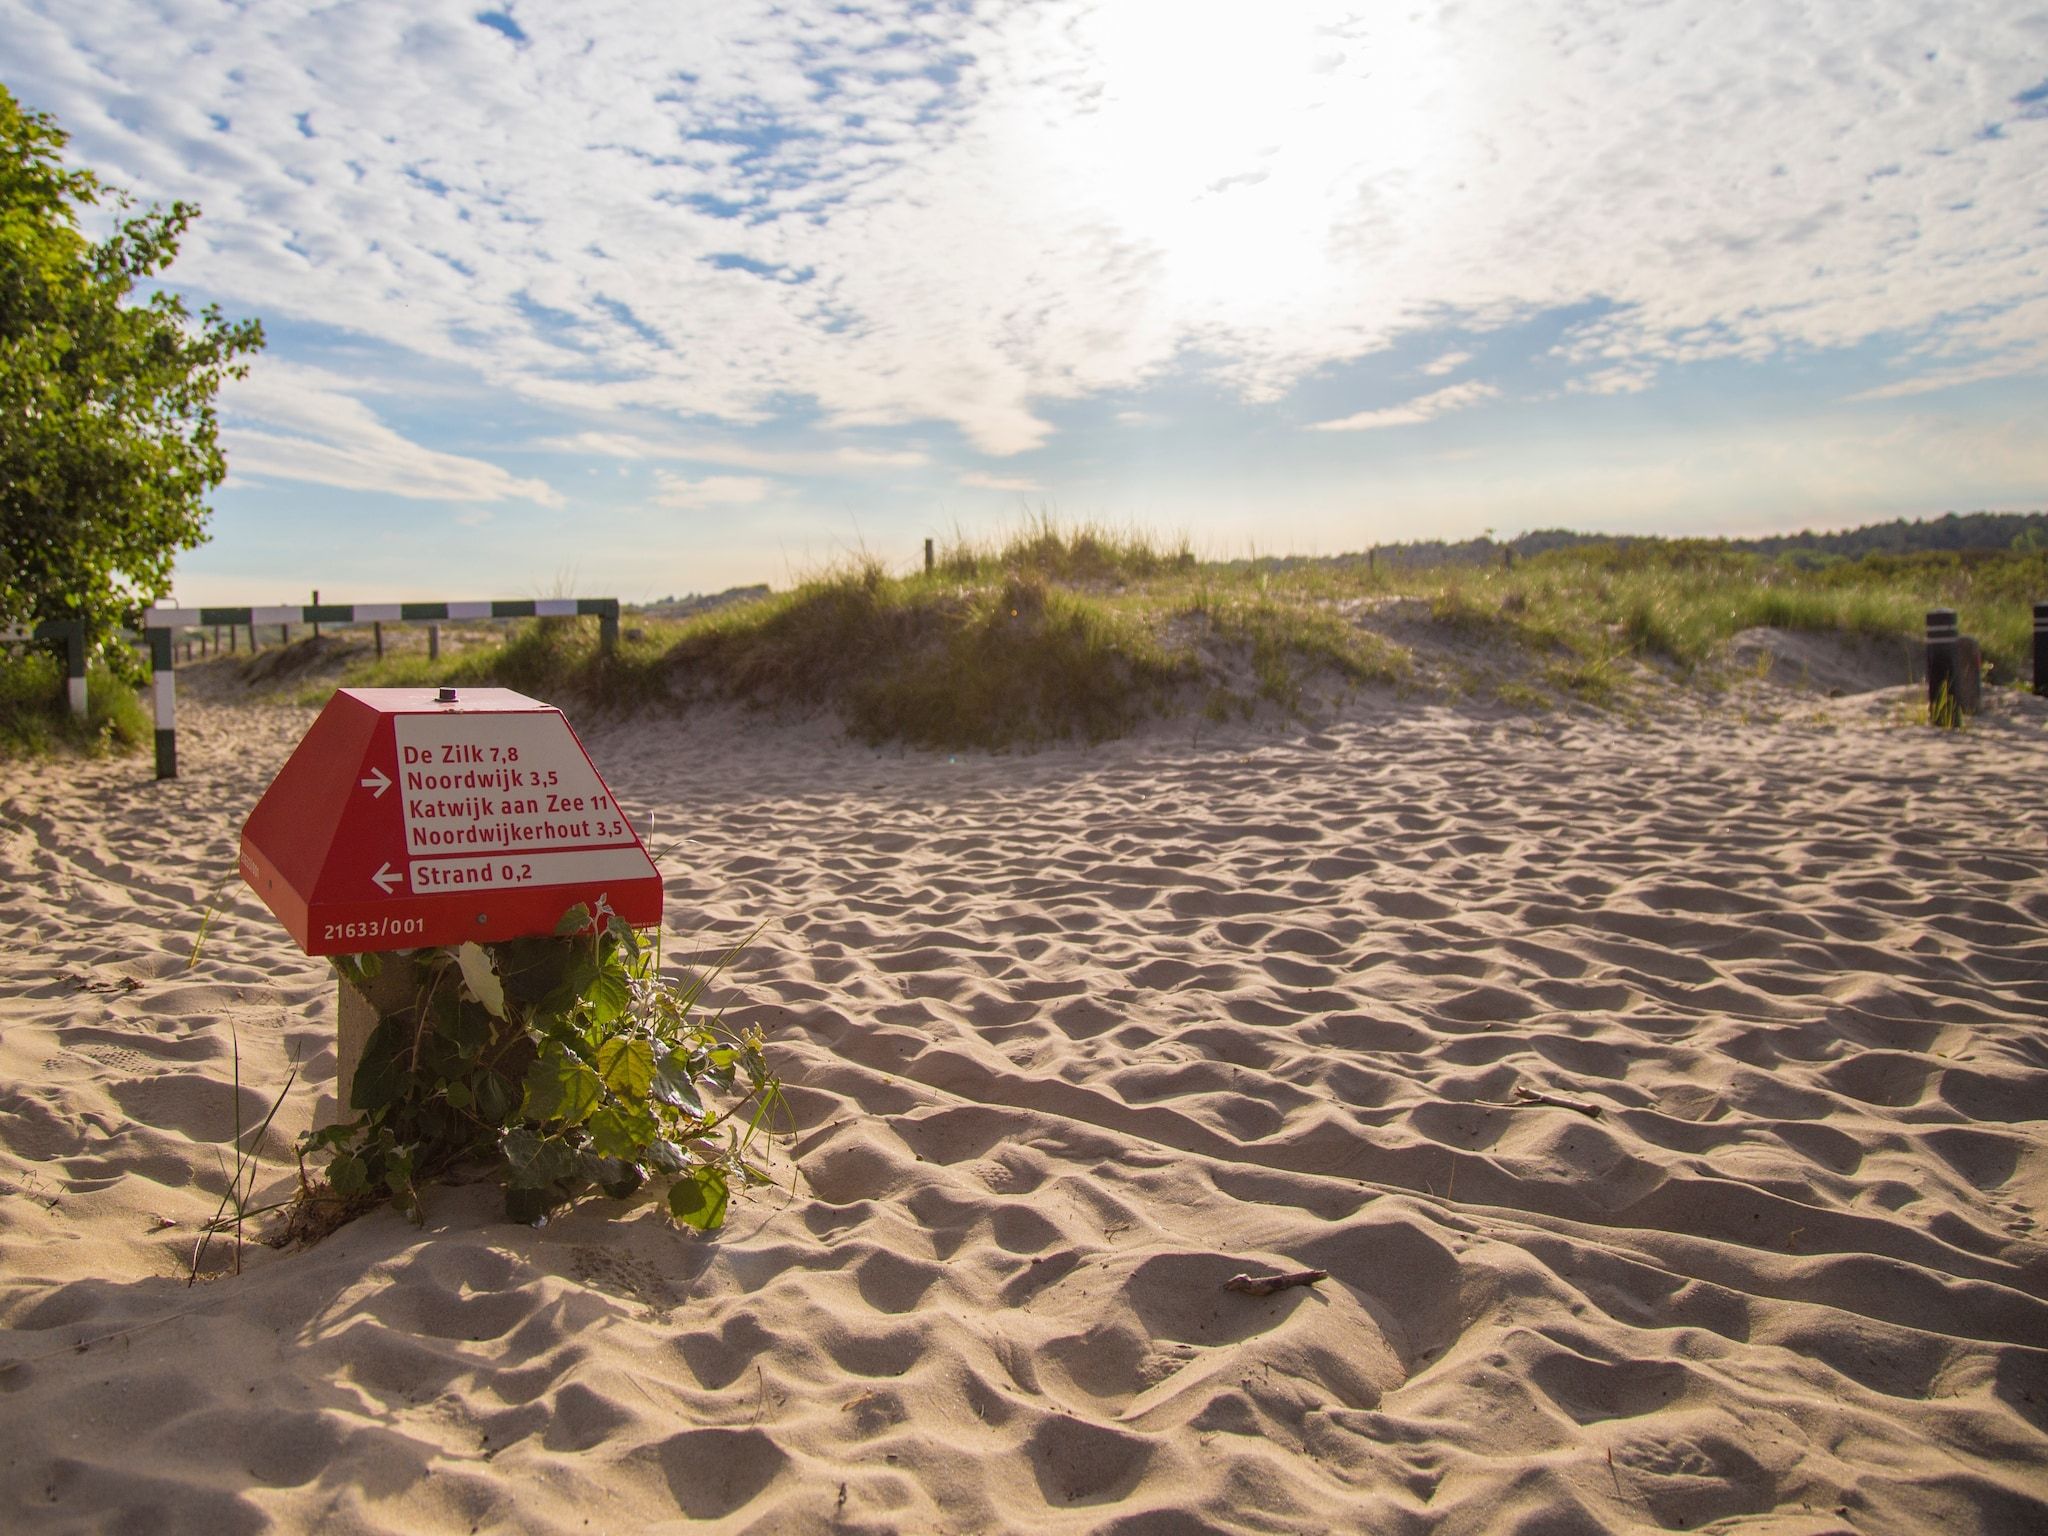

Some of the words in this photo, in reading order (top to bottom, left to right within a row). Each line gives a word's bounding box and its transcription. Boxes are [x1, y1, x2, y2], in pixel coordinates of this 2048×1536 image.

[404, 747, 432, 764] De
[442, 745, 483, 764] Zilk
[490, 747, 518, 765] 7,8
[408, 770, 523, 791] Noordwijk
[530, 772, 557, 788] 3,5
[410, 798, 493, 821] Katwijk
[501, 800, 538, 814] aan
[547, 795, 583, 812] Zee
[591, 796, 607, 810] 11
[413, 820, 590, 847] Noordwijkerhout
[597, 821, 622, 838] 3,5
[418, 864, 492, 886] Strand
[502, 864, 531, 881] 0,2
[324, 917, 423, 939] 21633/001
